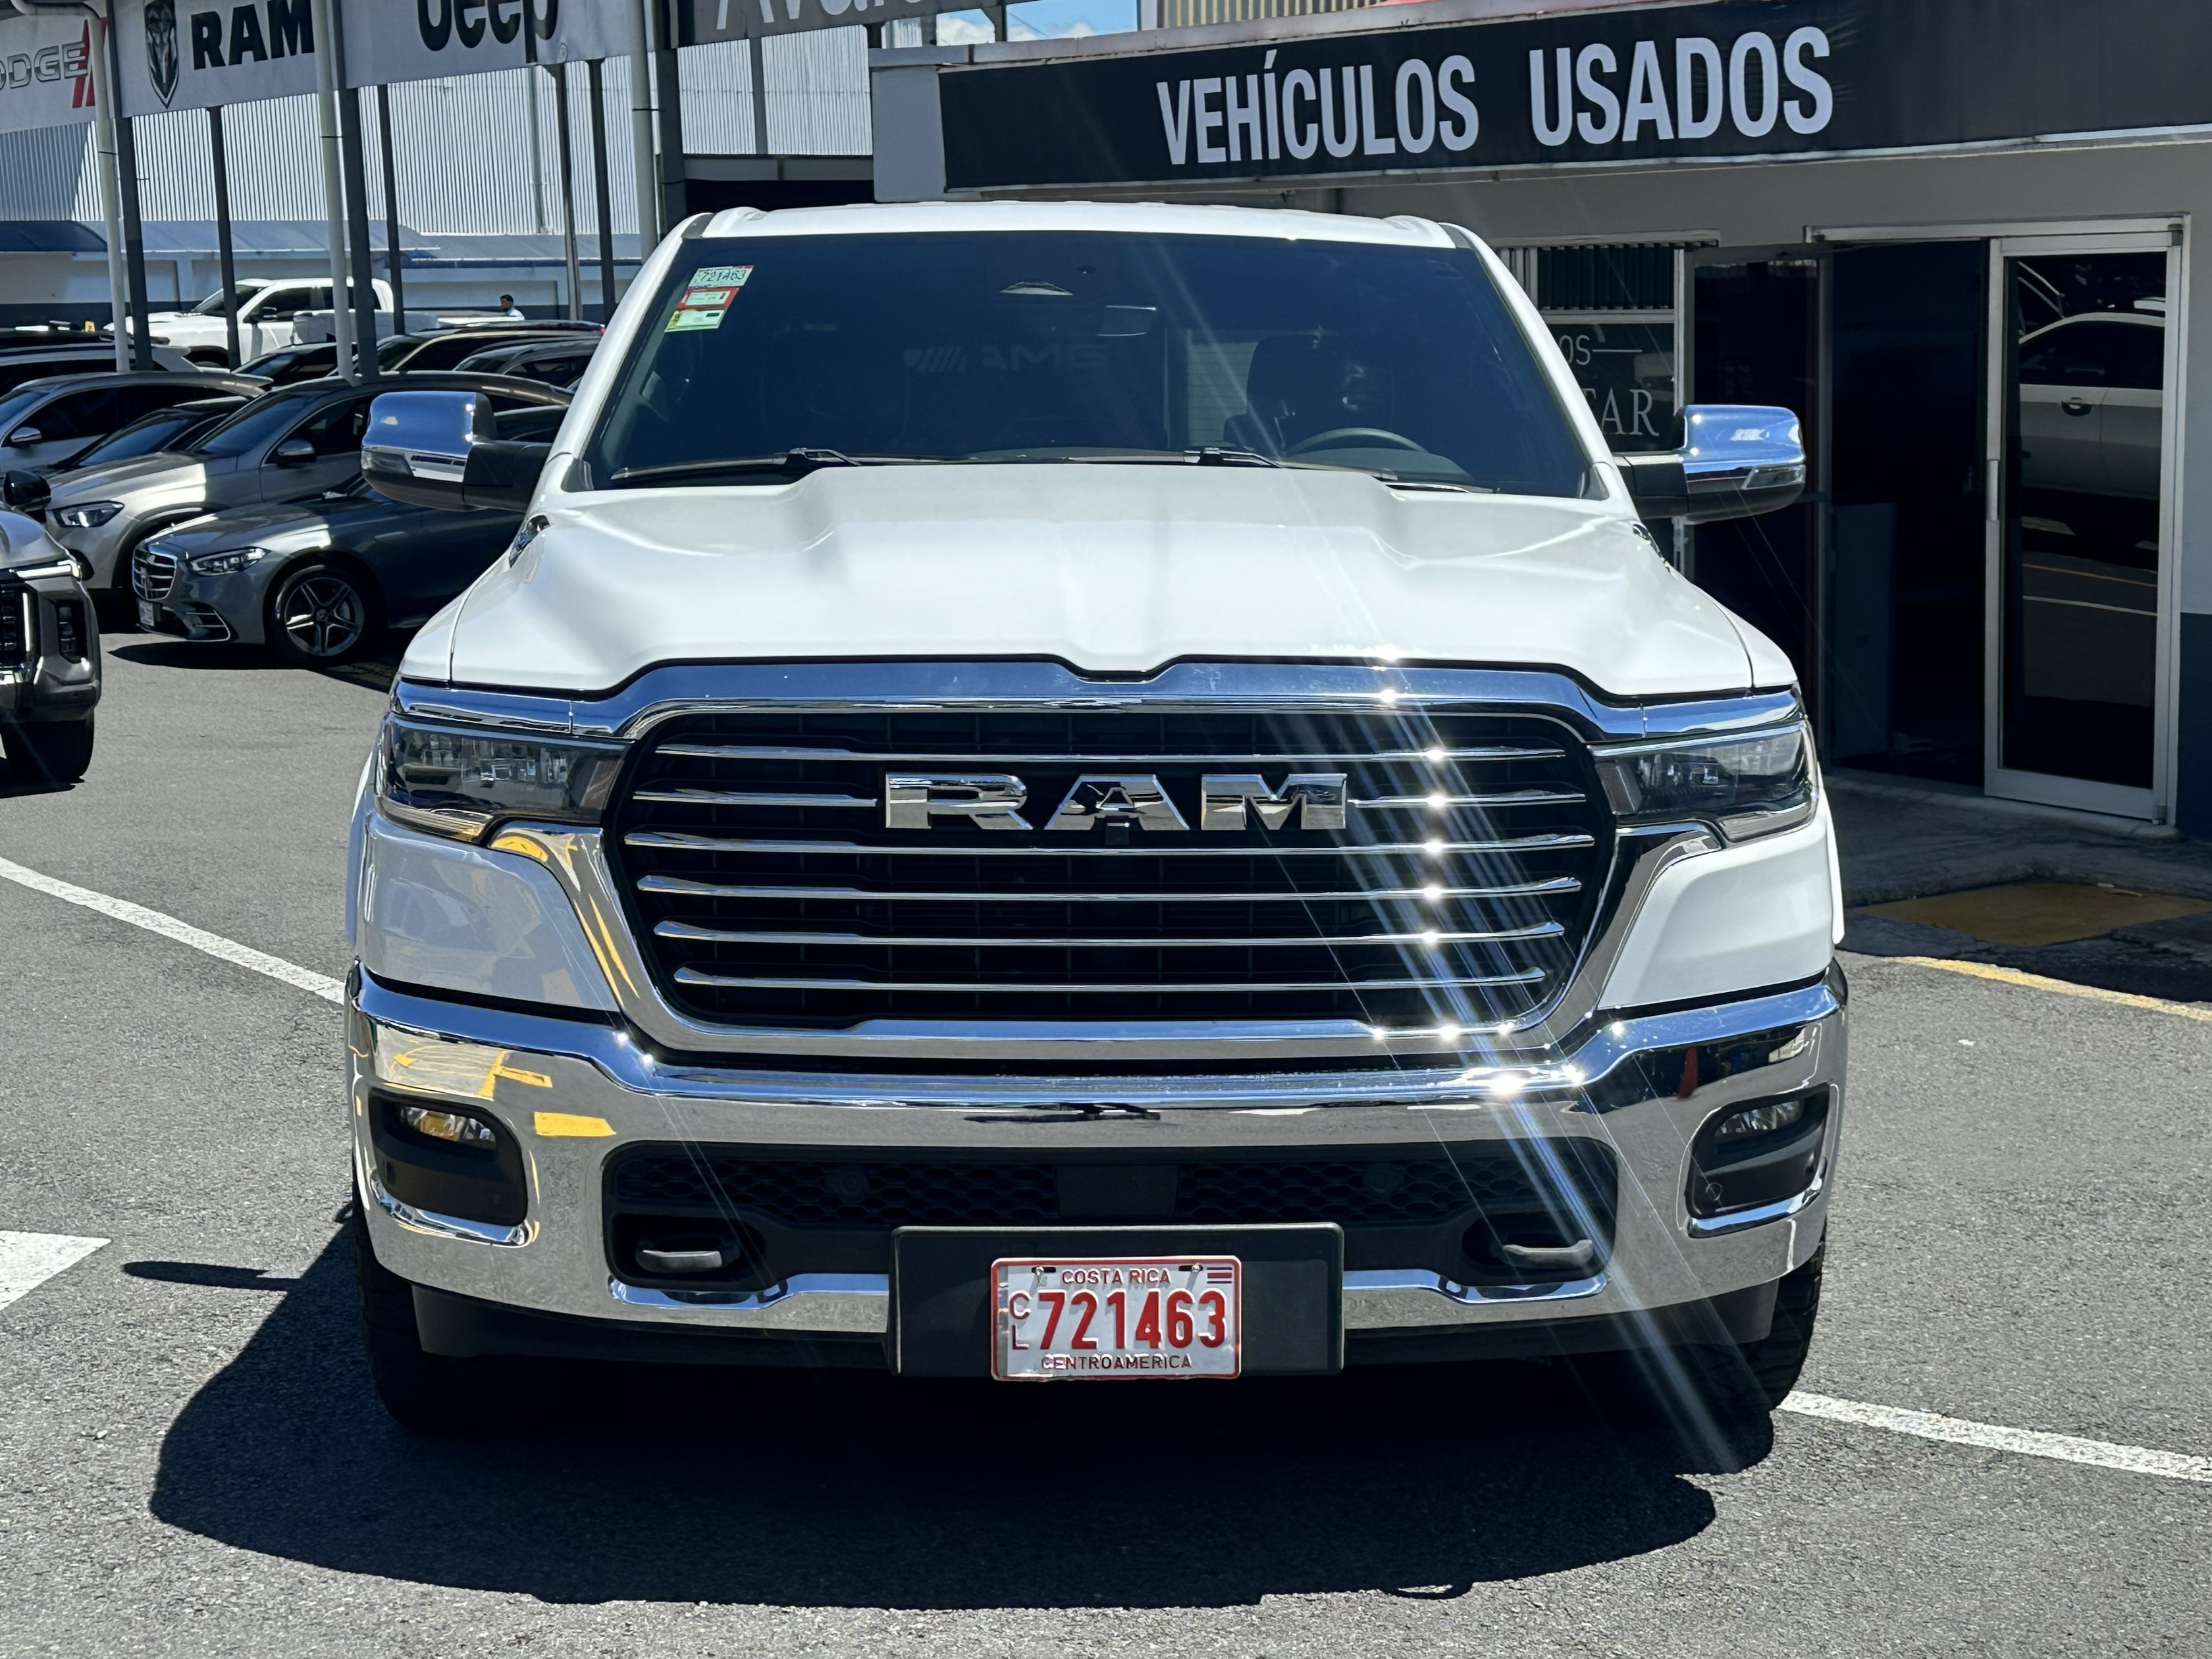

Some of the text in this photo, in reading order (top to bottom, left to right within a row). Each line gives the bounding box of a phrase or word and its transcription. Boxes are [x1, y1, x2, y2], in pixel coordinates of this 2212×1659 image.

[191, 0, 315, 70] RAM
[0, 41, 88, 91] DGE
[1156, 25, 1834, 167] VEHÍCULOS USADOS
[885, 772, 1347, 830] RAM
[1062, 1267, 1172, 1284] COSTA RICA
[1038, 1288, 1226, 1351] 721463
[1041, 1353, 1193, 1370] CENTROAMERICA
